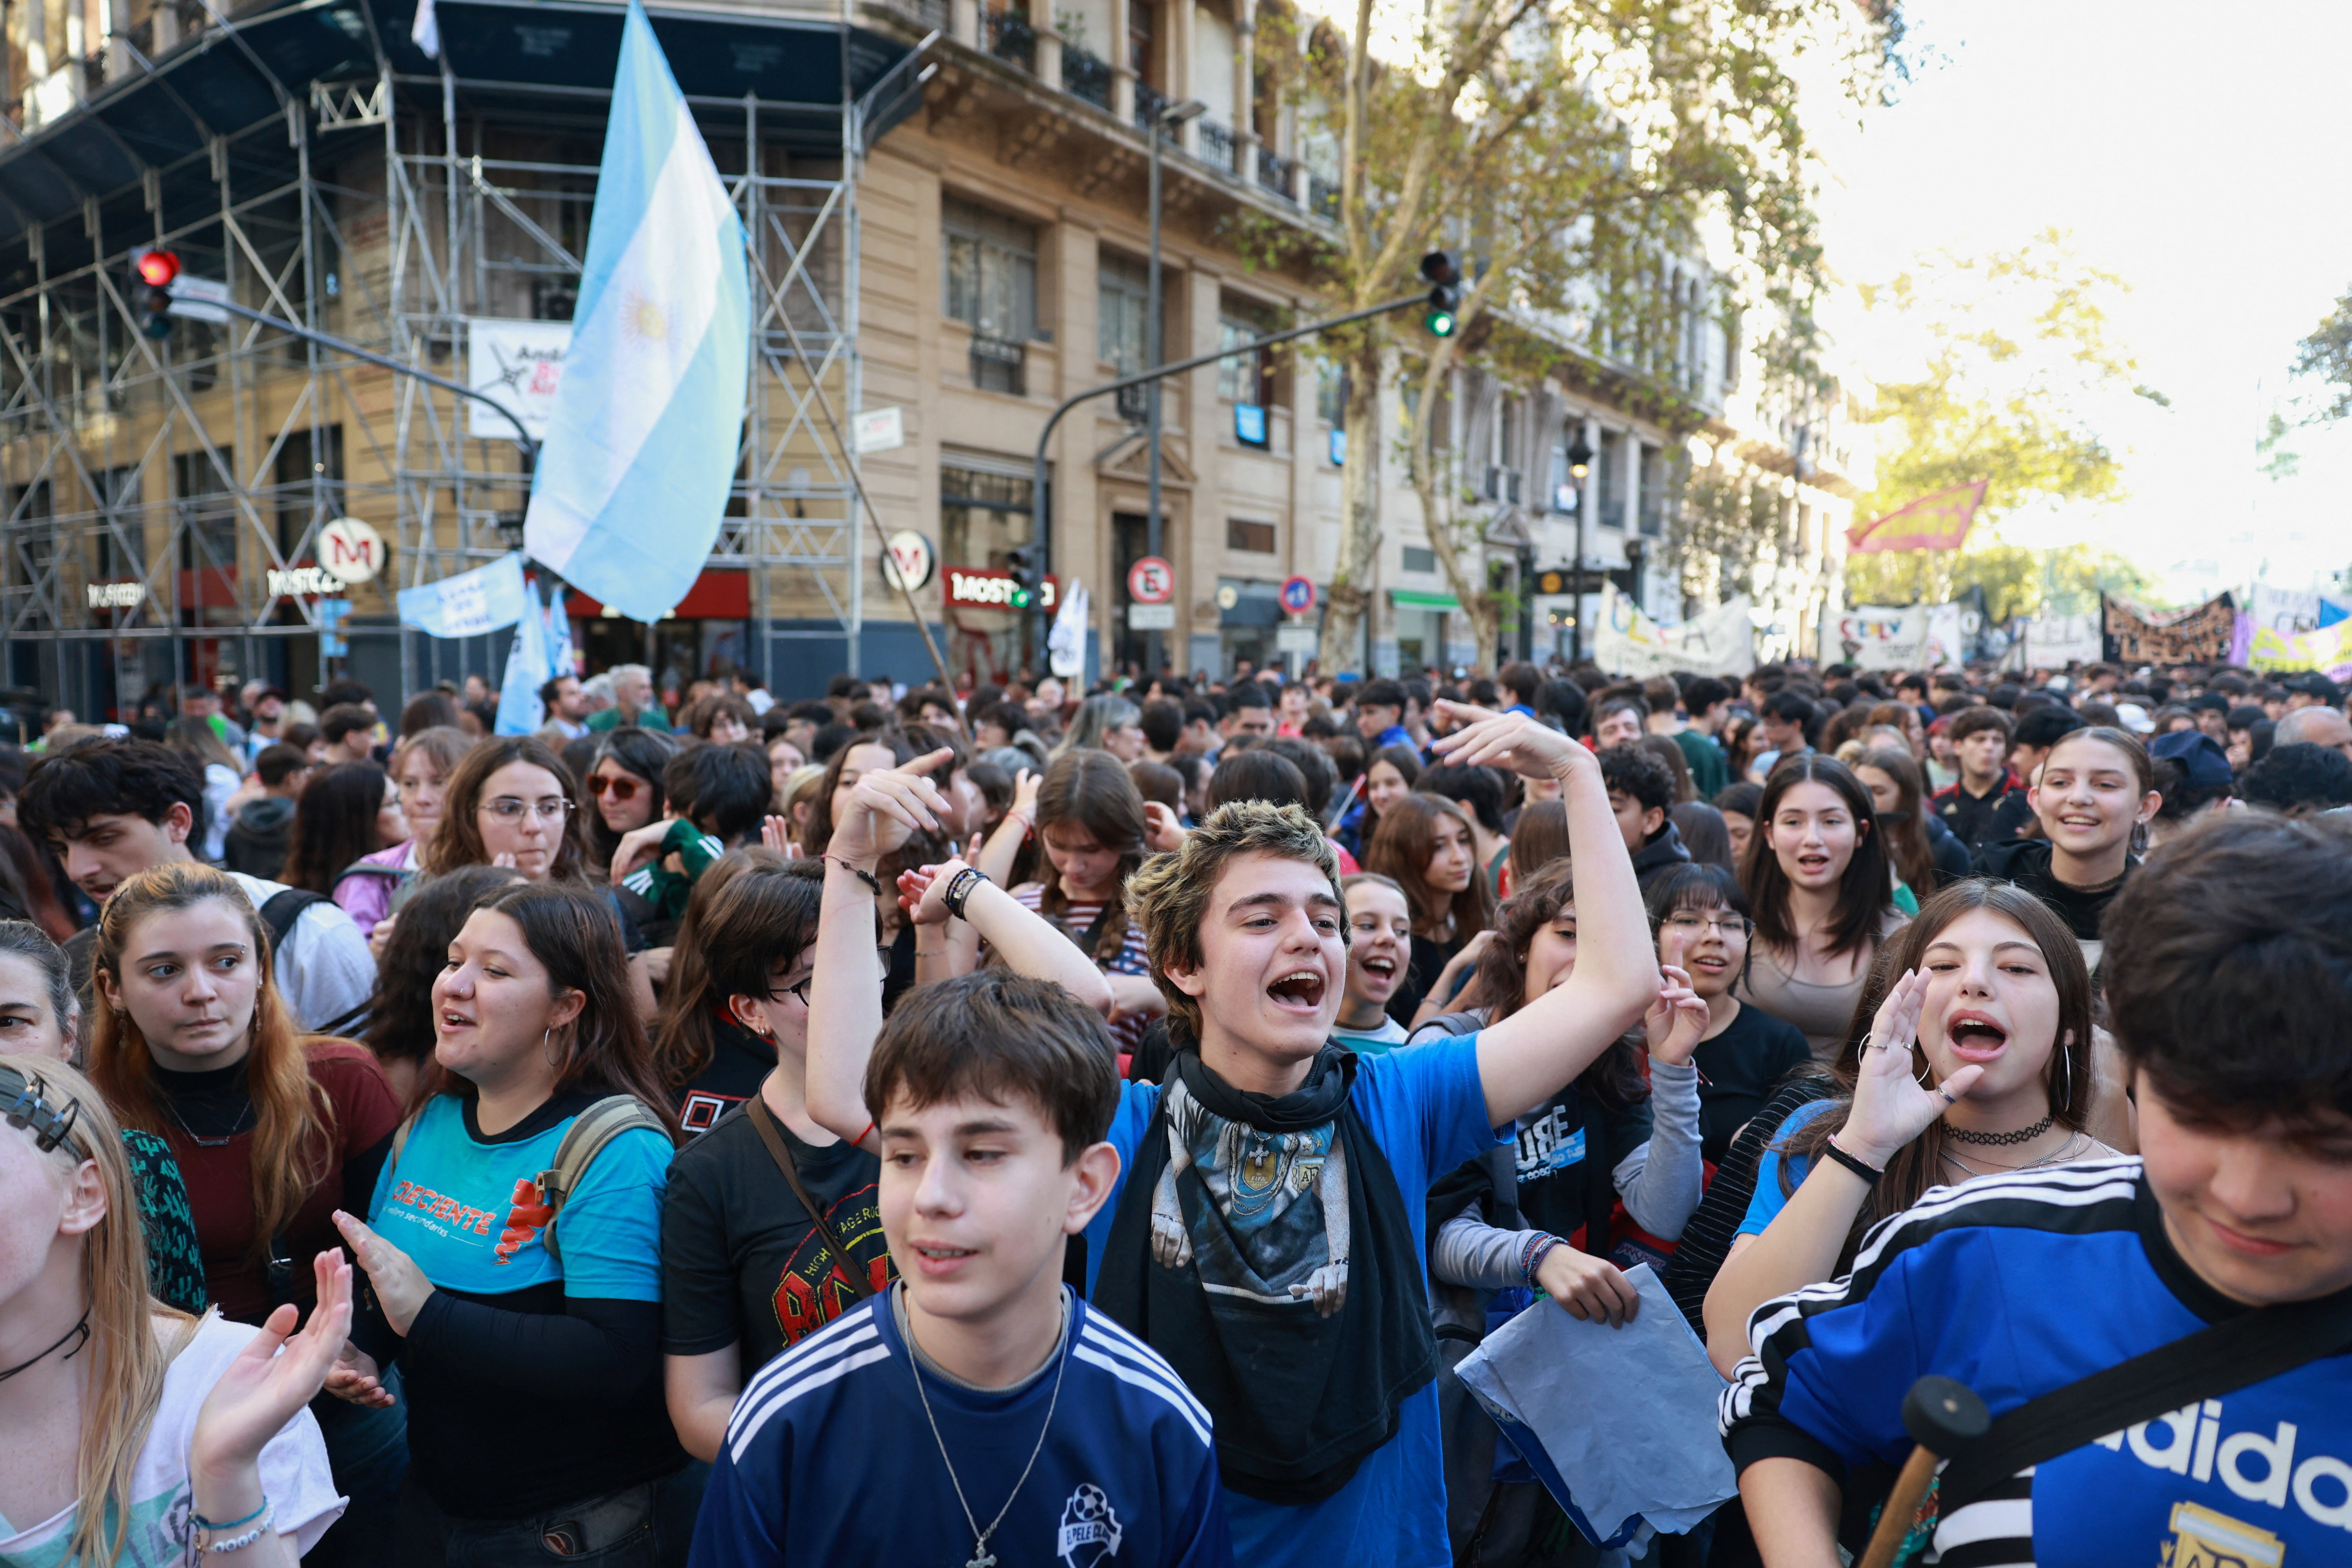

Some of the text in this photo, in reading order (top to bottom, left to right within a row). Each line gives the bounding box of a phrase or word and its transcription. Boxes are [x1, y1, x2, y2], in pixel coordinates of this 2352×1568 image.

[331, 534, 372, 568] M
[893, 547, 922, 575] M
[1143, 568, 1160, 593] E
[404, 1212, 448, 1238] secundarixs
[1615, 1242, 1667, 1272] JANSPORT
[2092, 1398, 2352, 1533] dida
[1072, 1526, 1091, 1541] PELE
